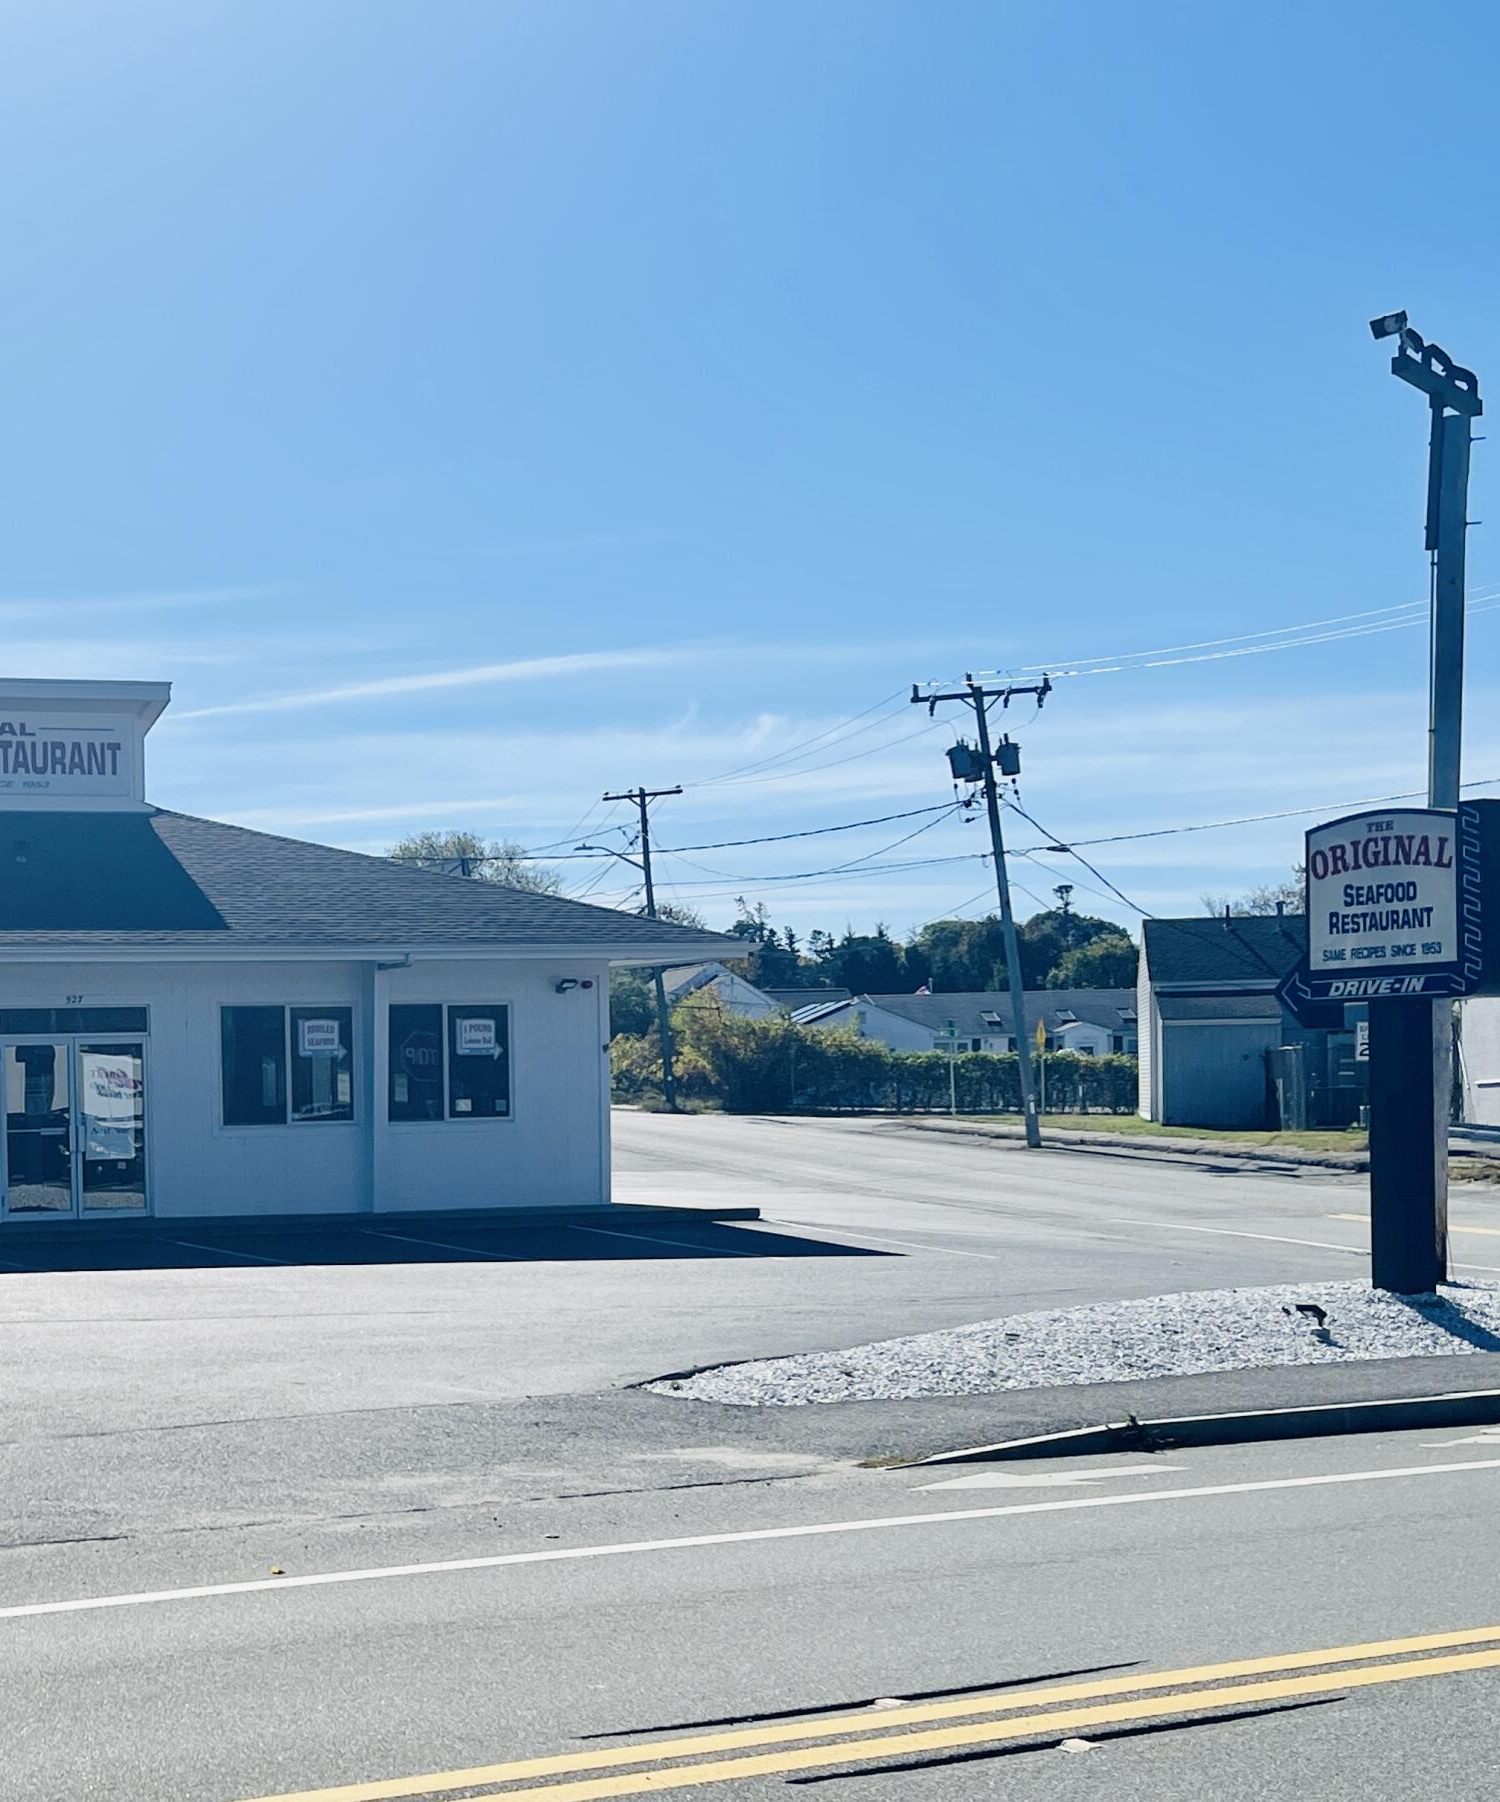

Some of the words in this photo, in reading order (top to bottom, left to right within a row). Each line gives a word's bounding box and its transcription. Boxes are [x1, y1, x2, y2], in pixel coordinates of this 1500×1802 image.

[1366, 820, 1394, 833] THE
[1310, 834, 1453, 881] ORIGINAL
[1343, 881, 1418, 908] SEAFOOD
[1328, 906, 1434, 935] RESTAURANT
[1322, 949, 1347, 962] SAME
[1350, 945, 1387, 960] RECIPES
[1390, 943, 1417, 956] SINCE
[1420, 941, 1443, 955] 1953
[1328, 977, 1426, 997] DRIVE-IN
[65, 995, 83, 1004] 527
